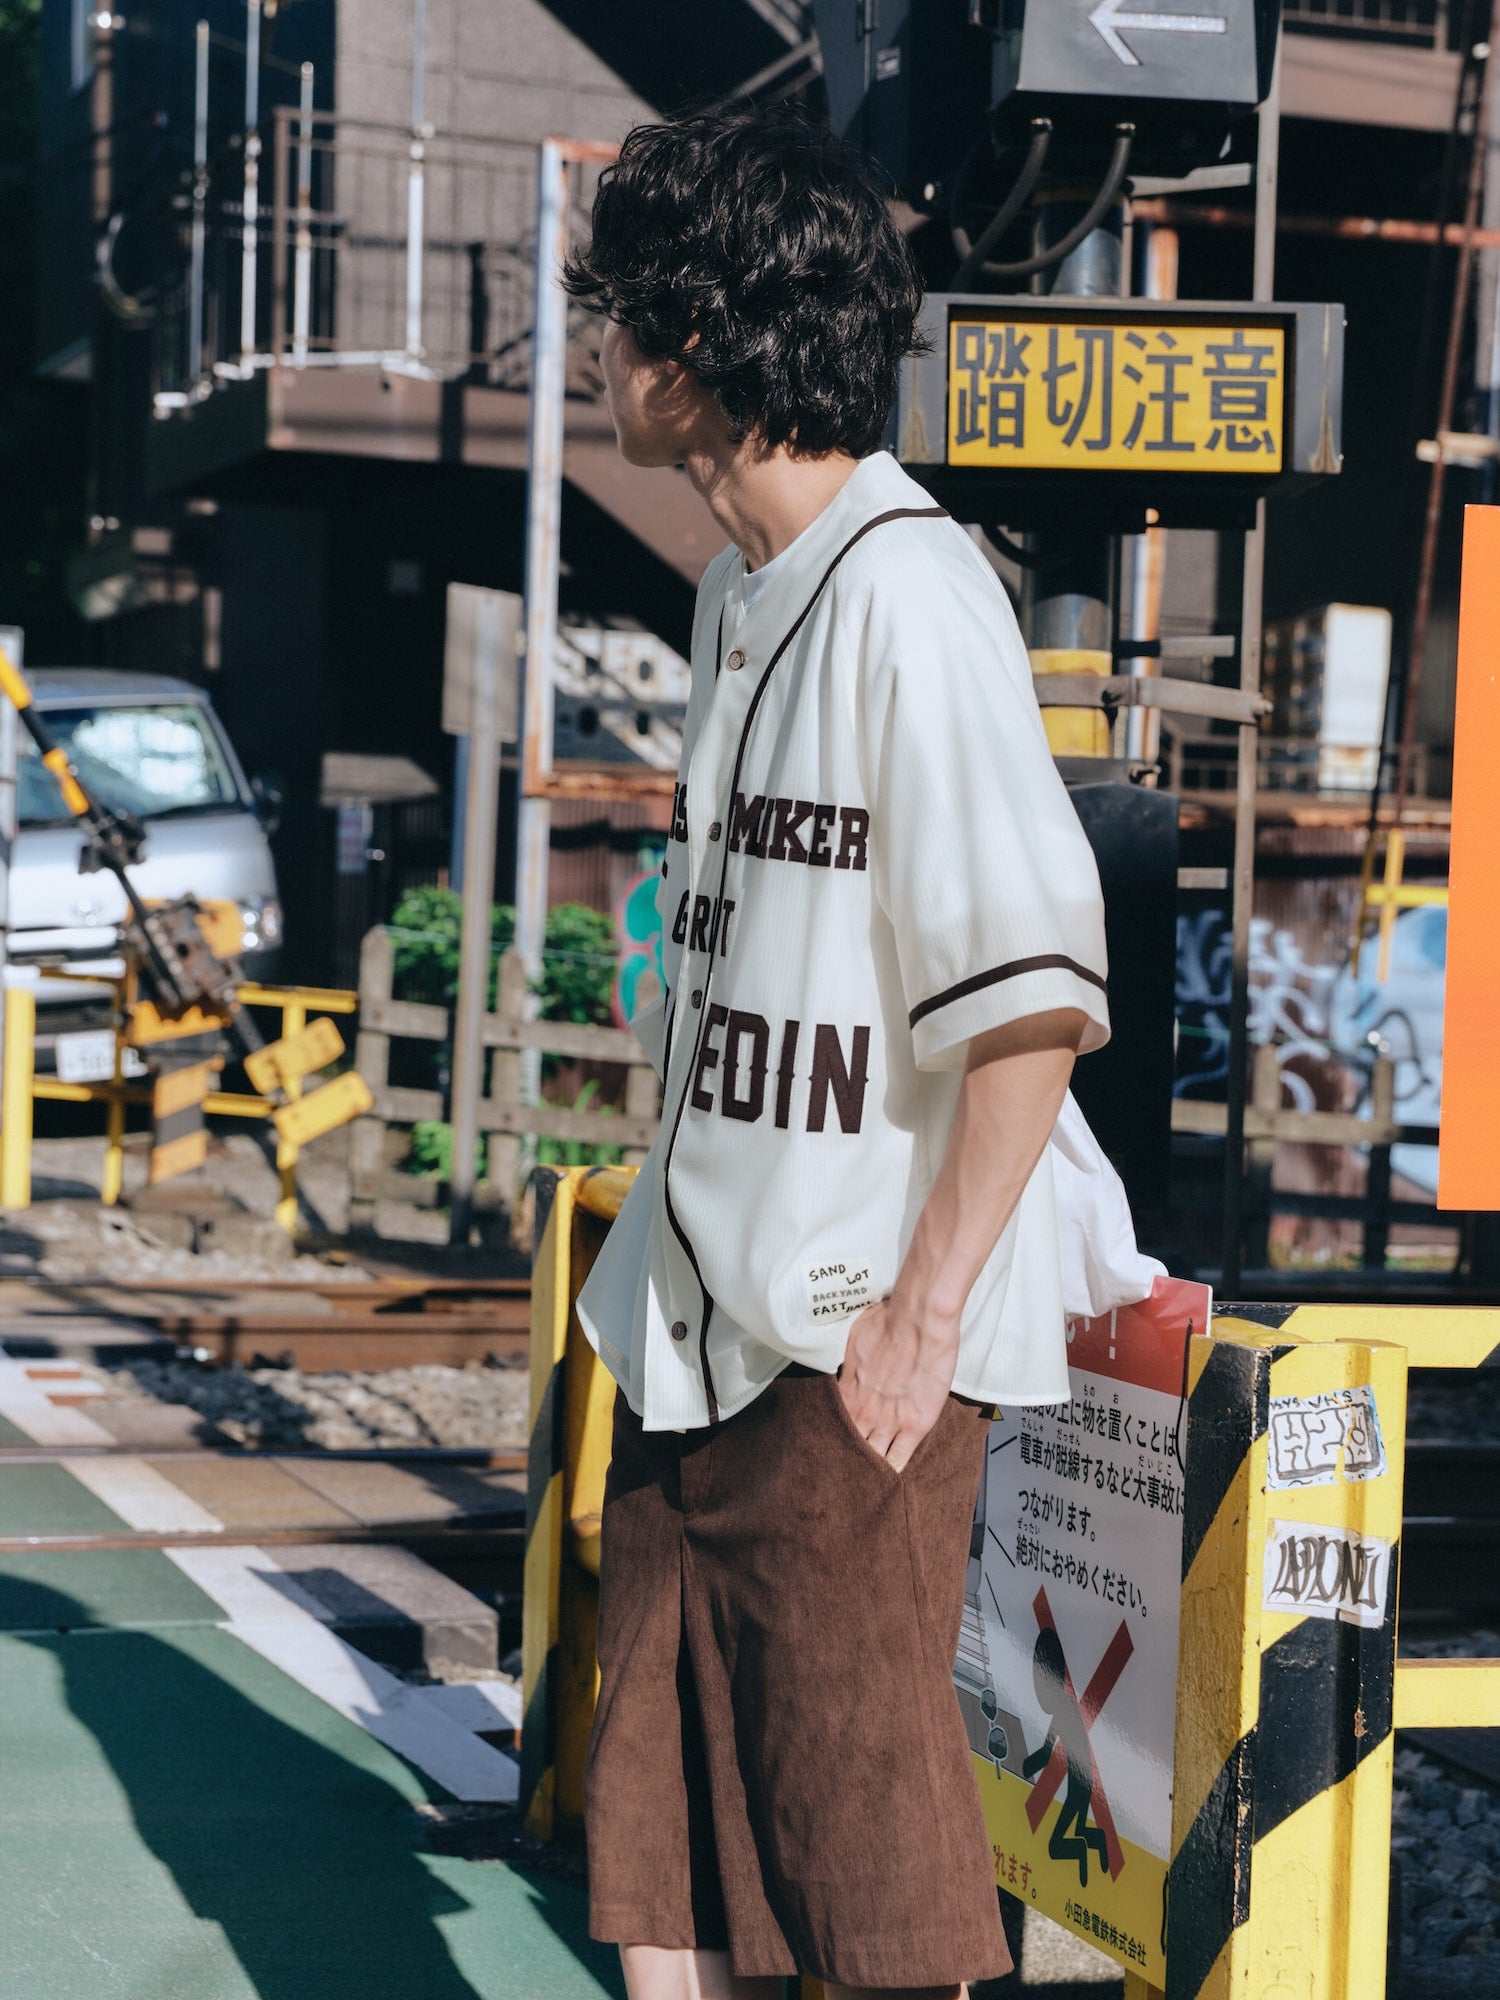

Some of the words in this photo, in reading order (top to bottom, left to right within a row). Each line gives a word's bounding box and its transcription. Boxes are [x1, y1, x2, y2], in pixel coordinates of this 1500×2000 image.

[955, 325, 1277, 454] 踏切注意
[809, 1264, 846, 1281] SAND
[846, 1269, 869, 1285] LOT
[812, 1287, 867, 1303] BACKYARD
[1084, 1384, 1095, 1396] もの
[1113, 1393, 1119, 1404] お
[1021, 1418, 1044, 1433] でんしゃ
[1057, 1428, 1080, 1446] だっせん
[1138, 1455, 1172, 1476] だいじこ
[1018, 1488, 1095, 1542] つながります。
[1016, 1533, 1147, 1617] 絶対におやめください。
[1065, 1898, 1147, 1967] 小田急電鉄株式会社
